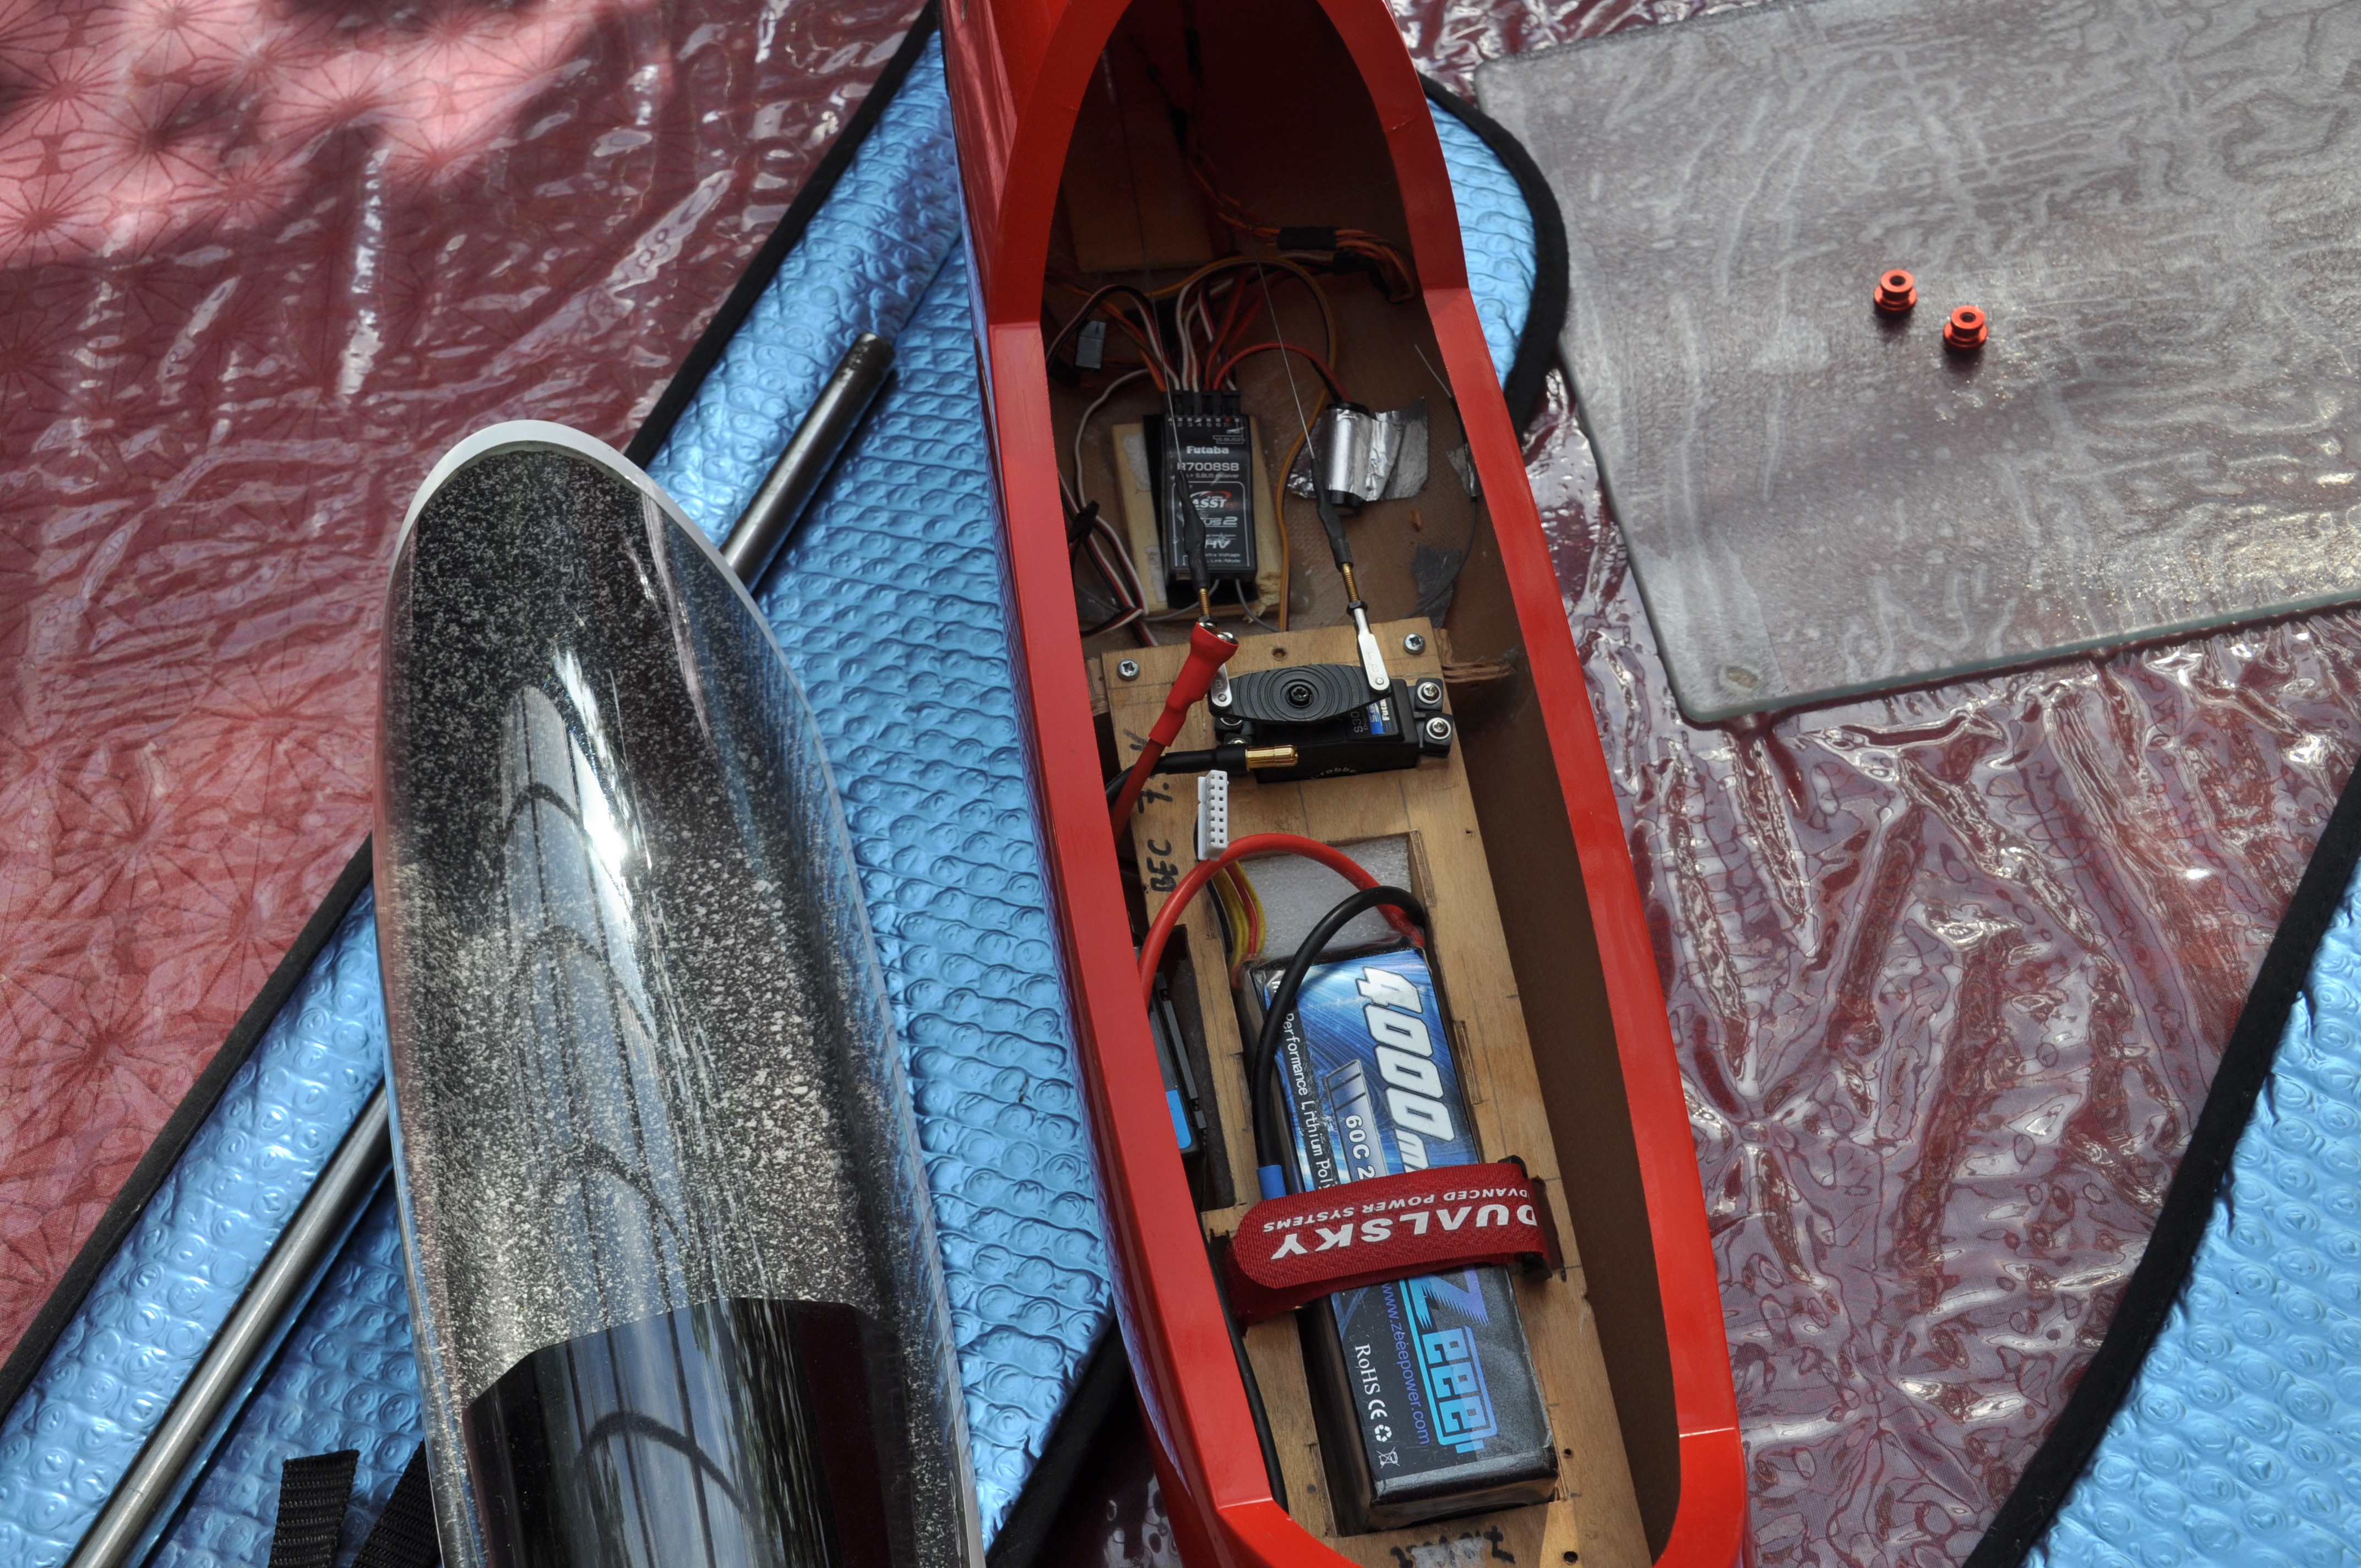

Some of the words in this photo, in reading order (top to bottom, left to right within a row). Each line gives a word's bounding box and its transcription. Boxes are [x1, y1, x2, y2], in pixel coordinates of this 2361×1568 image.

[1177, 462, 1239, 471] R7008SB
[1186, 445, 1230, 454] Futaba
[1351, 710, 1363, 733] S30
[1146, 839, 1178, 892] BEC
[1283, 1012, 1308, 1096] Performance
[1300, 1099, 1324, 1155] Lithium
[1356, 966, 1455, 1173] 4000m
[1345, 1114, 1371, 1160] 60C
[1357, 1164, 1376, 1181] 2
[1362, 1194, 1435, 1213] POWER
[1443, 1188, 1531, 1202] DVANCED
[1263, 1206, 1356, 1233] SYSTEMS
[1270, 1204, 1538, 1260] DUALSKY
[1354, 1343, 1381, 1396] RoHS
[1381, 1282, 1430, 1445] www.zeeepower.com
